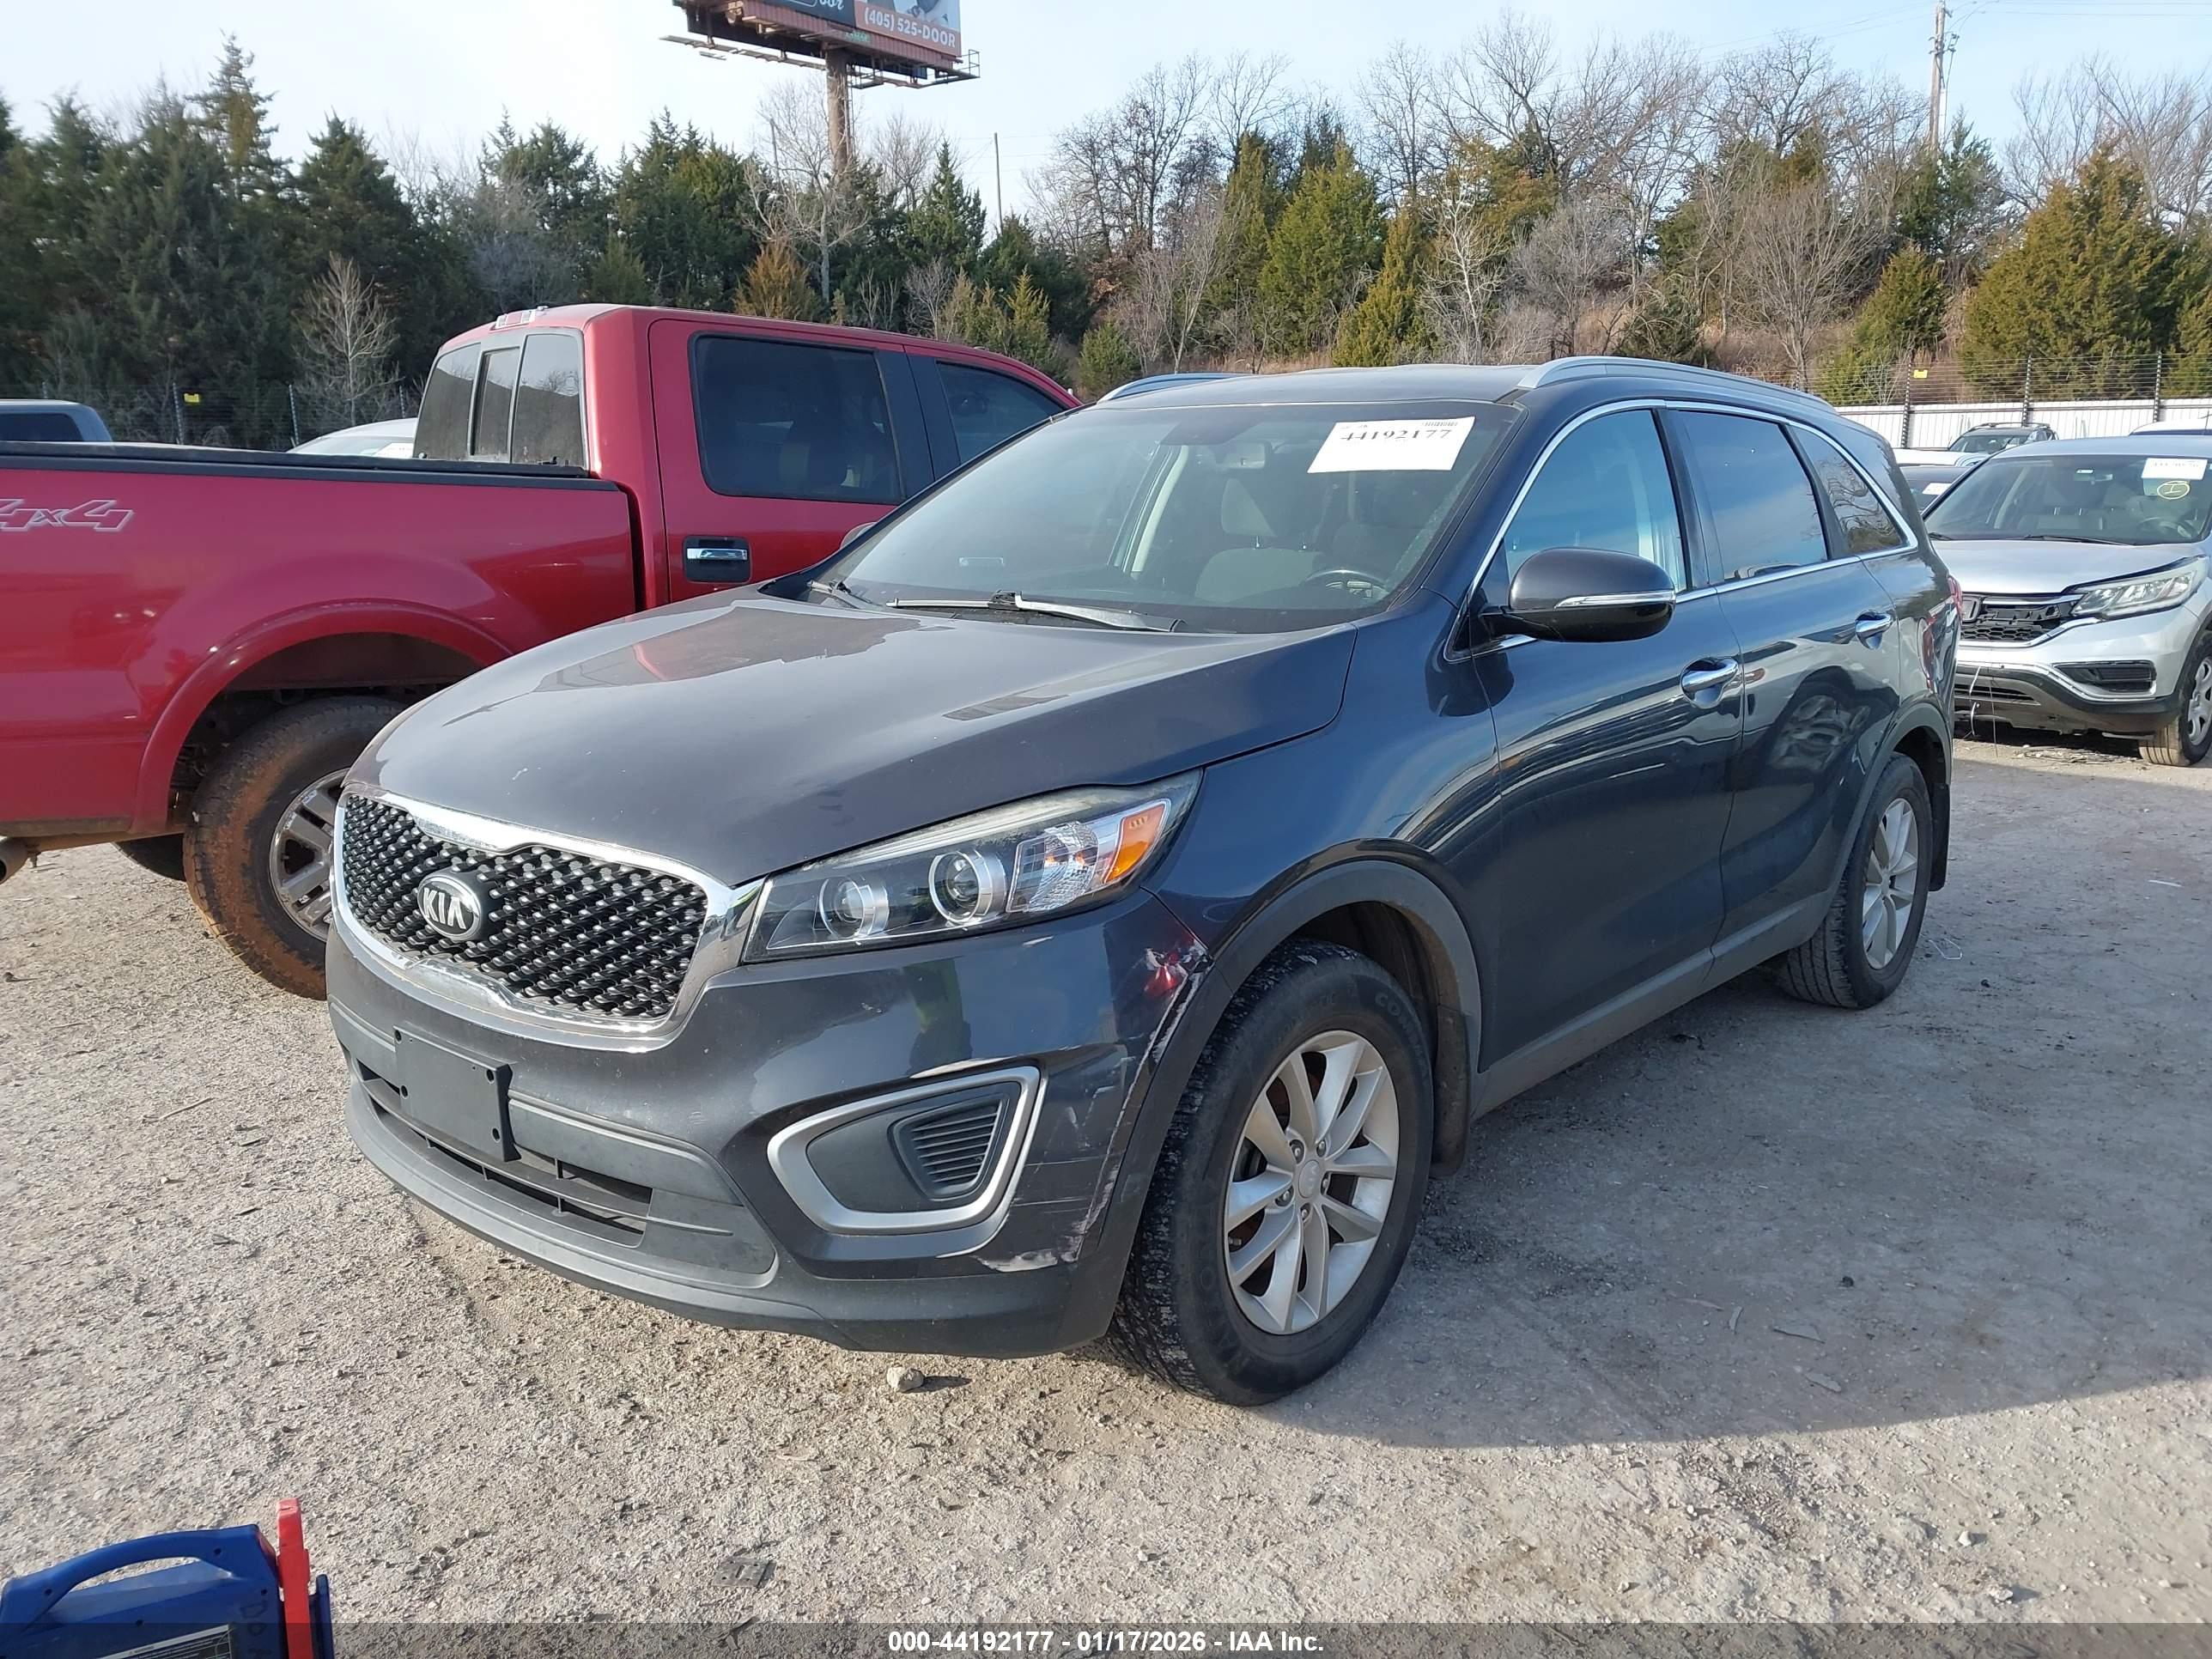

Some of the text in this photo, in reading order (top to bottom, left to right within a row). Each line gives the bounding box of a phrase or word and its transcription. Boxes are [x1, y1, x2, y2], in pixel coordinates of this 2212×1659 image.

[864, 8, 895, 31] (405)
[897, 17, 956, 48] 525-DOOR
[1340, 428, 1452, 441] 44192177
[422, 886, 467, 930] KIA
